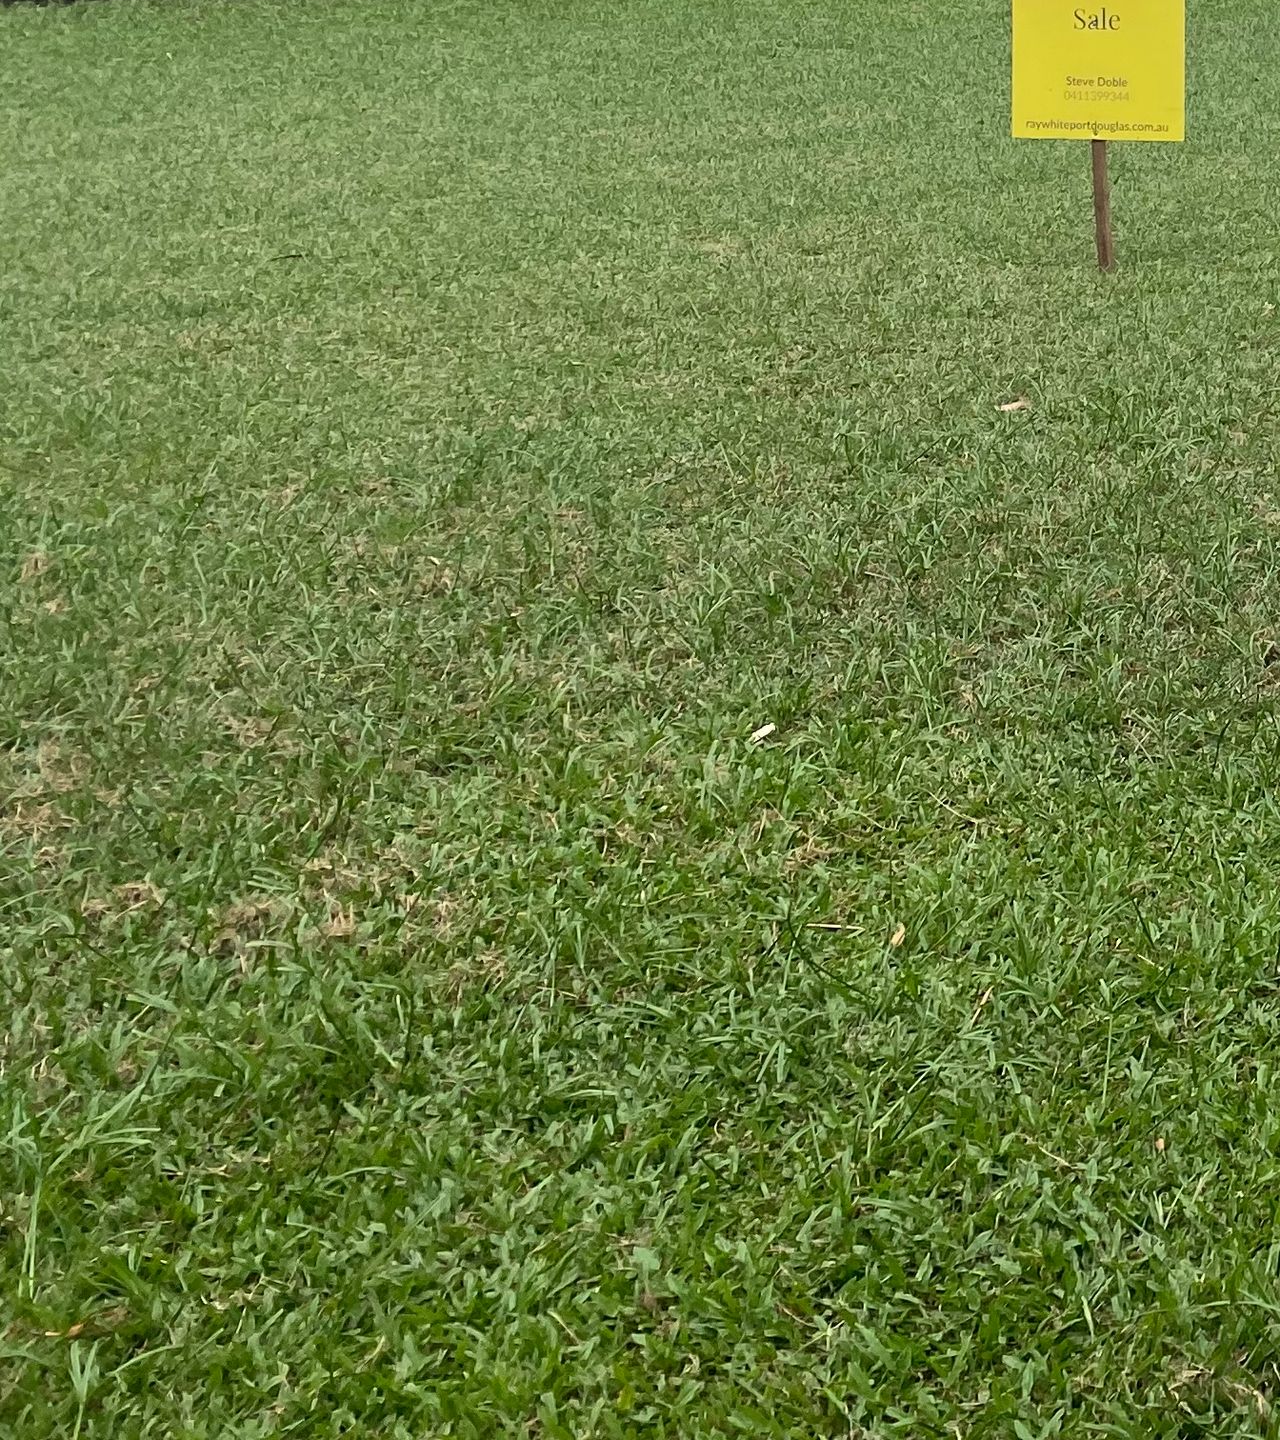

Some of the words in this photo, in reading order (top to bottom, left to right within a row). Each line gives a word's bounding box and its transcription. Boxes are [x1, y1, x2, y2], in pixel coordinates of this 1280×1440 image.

[1073, 7, 1121, 31] Sale
[1066, 75, 1095, 87] Steve
[1097, 76, 1128, 88] Doble
[1026, 119, 1169, 133] raywhiteportdouglas.com.au
